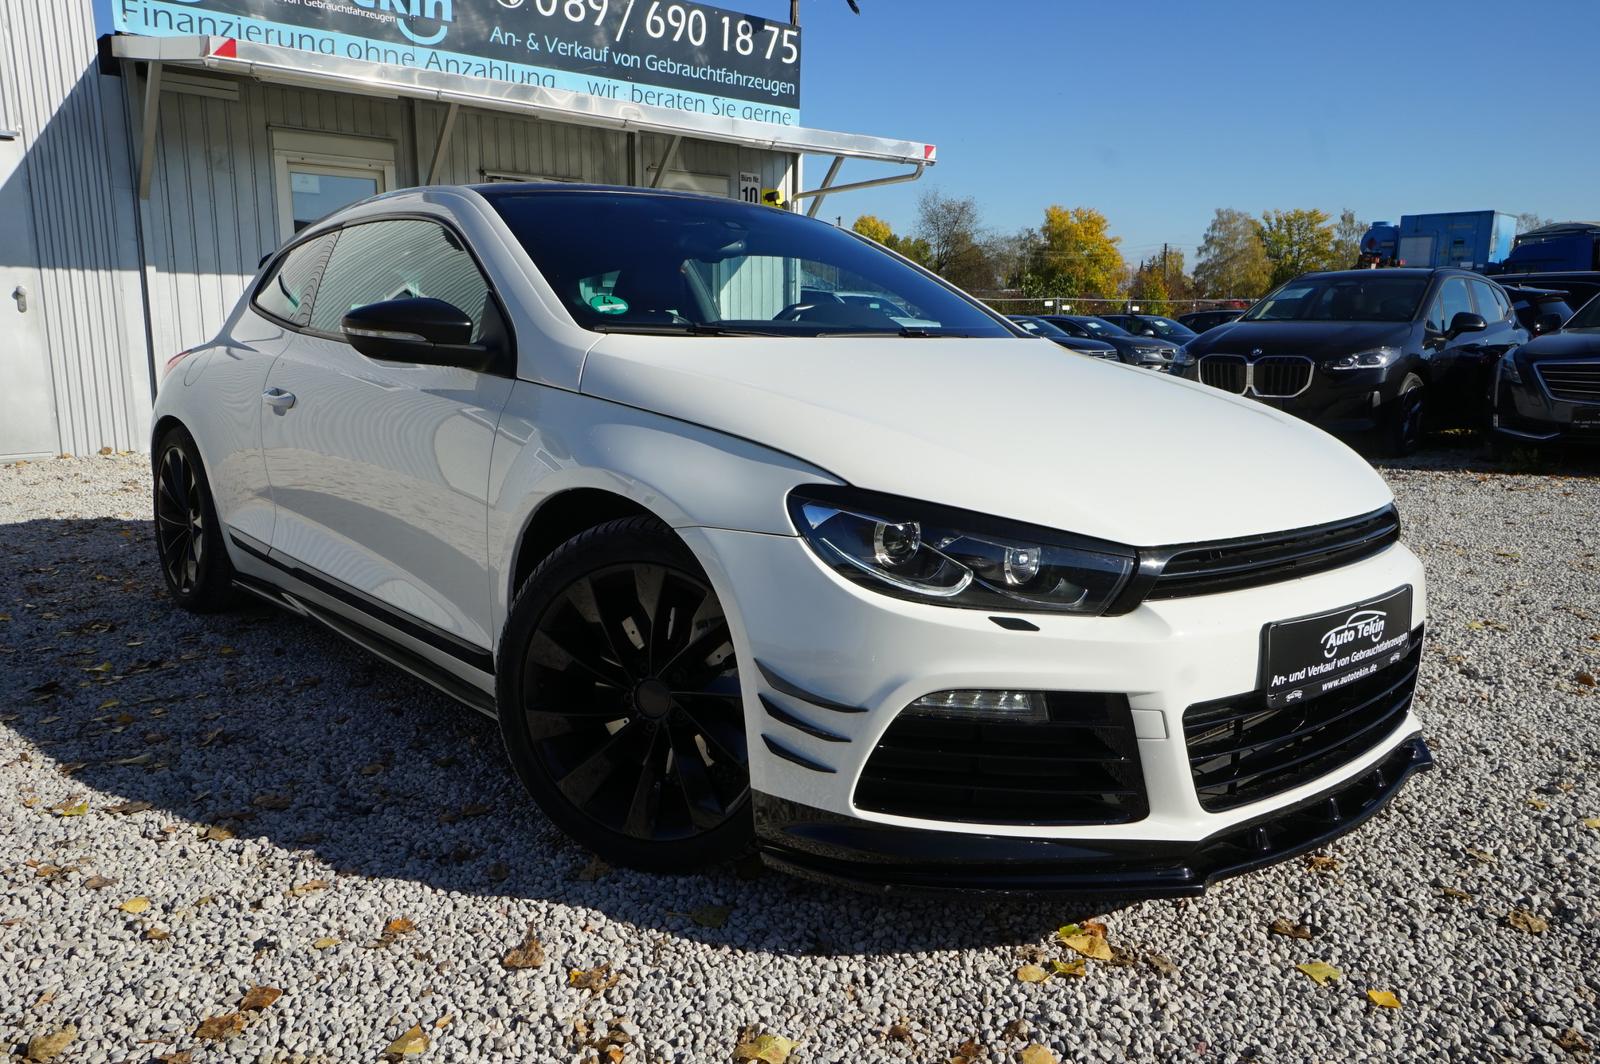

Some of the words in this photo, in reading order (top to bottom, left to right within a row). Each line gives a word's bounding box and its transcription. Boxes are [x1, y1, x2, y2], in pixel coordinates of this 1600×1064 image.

[304, 0, 396, 23] Gebrauchtfahrzeugen
[645, 1, 707, 46] 690
[721, 16, 754, 56] 18
[764, 24, 798, 64] 75
[346, 40, 415, 66] ohne
[587, 80, 619, 100] wir
[631, 84, 706, 114] beraten
[711, 97, 736, 118] Sie
[489, 26, 521, 46] An-
[526, 32, 540, 51] &
[544, 35, 610, 63] Verkauf
[612, 52, 640, 69] von
[645, 54, 796, 96] Gebrauchtfahrzeugen
[742, 186, 758, 203] 10
[1326, 632, 1355, 649] Auto
[1357, 619, 1385, 639] Tekin
[1271, 674, 1287, 687] An-
[1289, 669, 1306, 683] und
[1307, 657, 1337, 678] Verkauf
[1336, 656, 1350, 668] von
[1350, 631, 1408, 663] Gebrauchtfahrzeugen
[1321, 663, 1378, 691] www.autotekin.de
